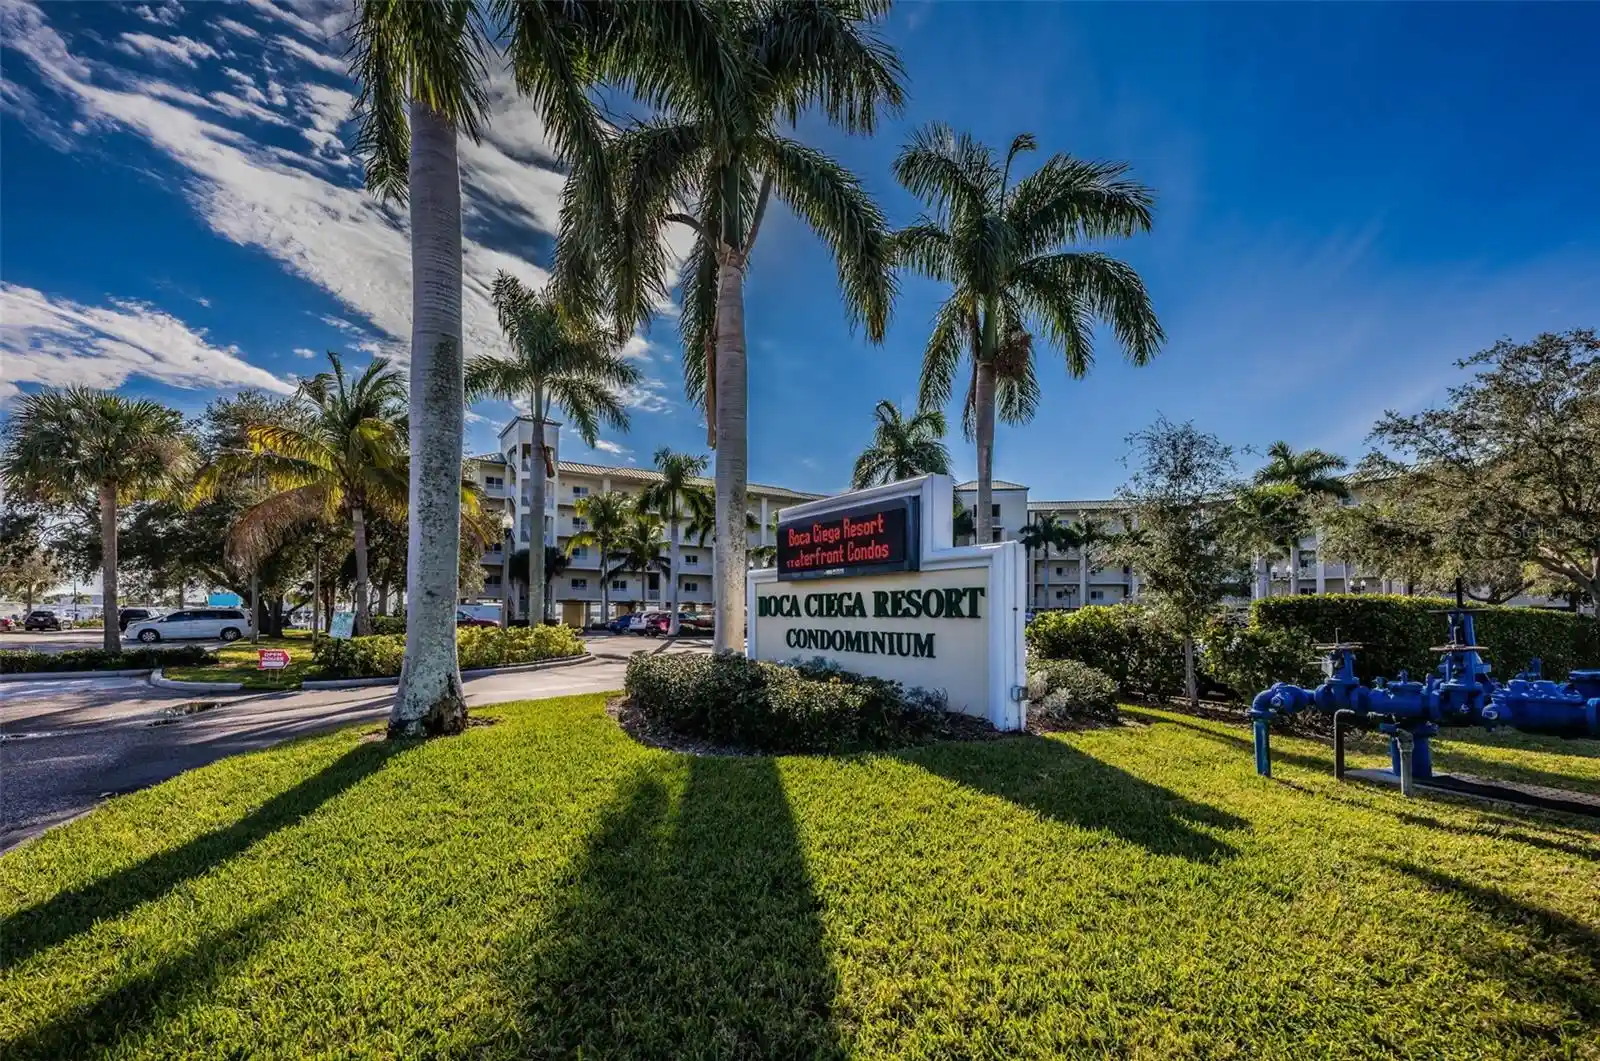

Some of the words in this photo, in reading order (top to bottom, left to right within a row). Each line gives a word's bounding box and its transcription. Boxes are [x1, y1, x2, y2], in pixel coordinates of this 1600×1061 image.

[788, 528, 811, 547] Boca
[813, 523, 840, 544] Ciega
[843, 513, 884, 539] Resort
[847, 540, 889, 562] Condos
[758, 595, 801, 617] BOCA
[804, 592, 867, 618] CIEGA
[872, 587, 985, 619] RESORT
[786, 628, 936, 659] CONDOMINIUM
